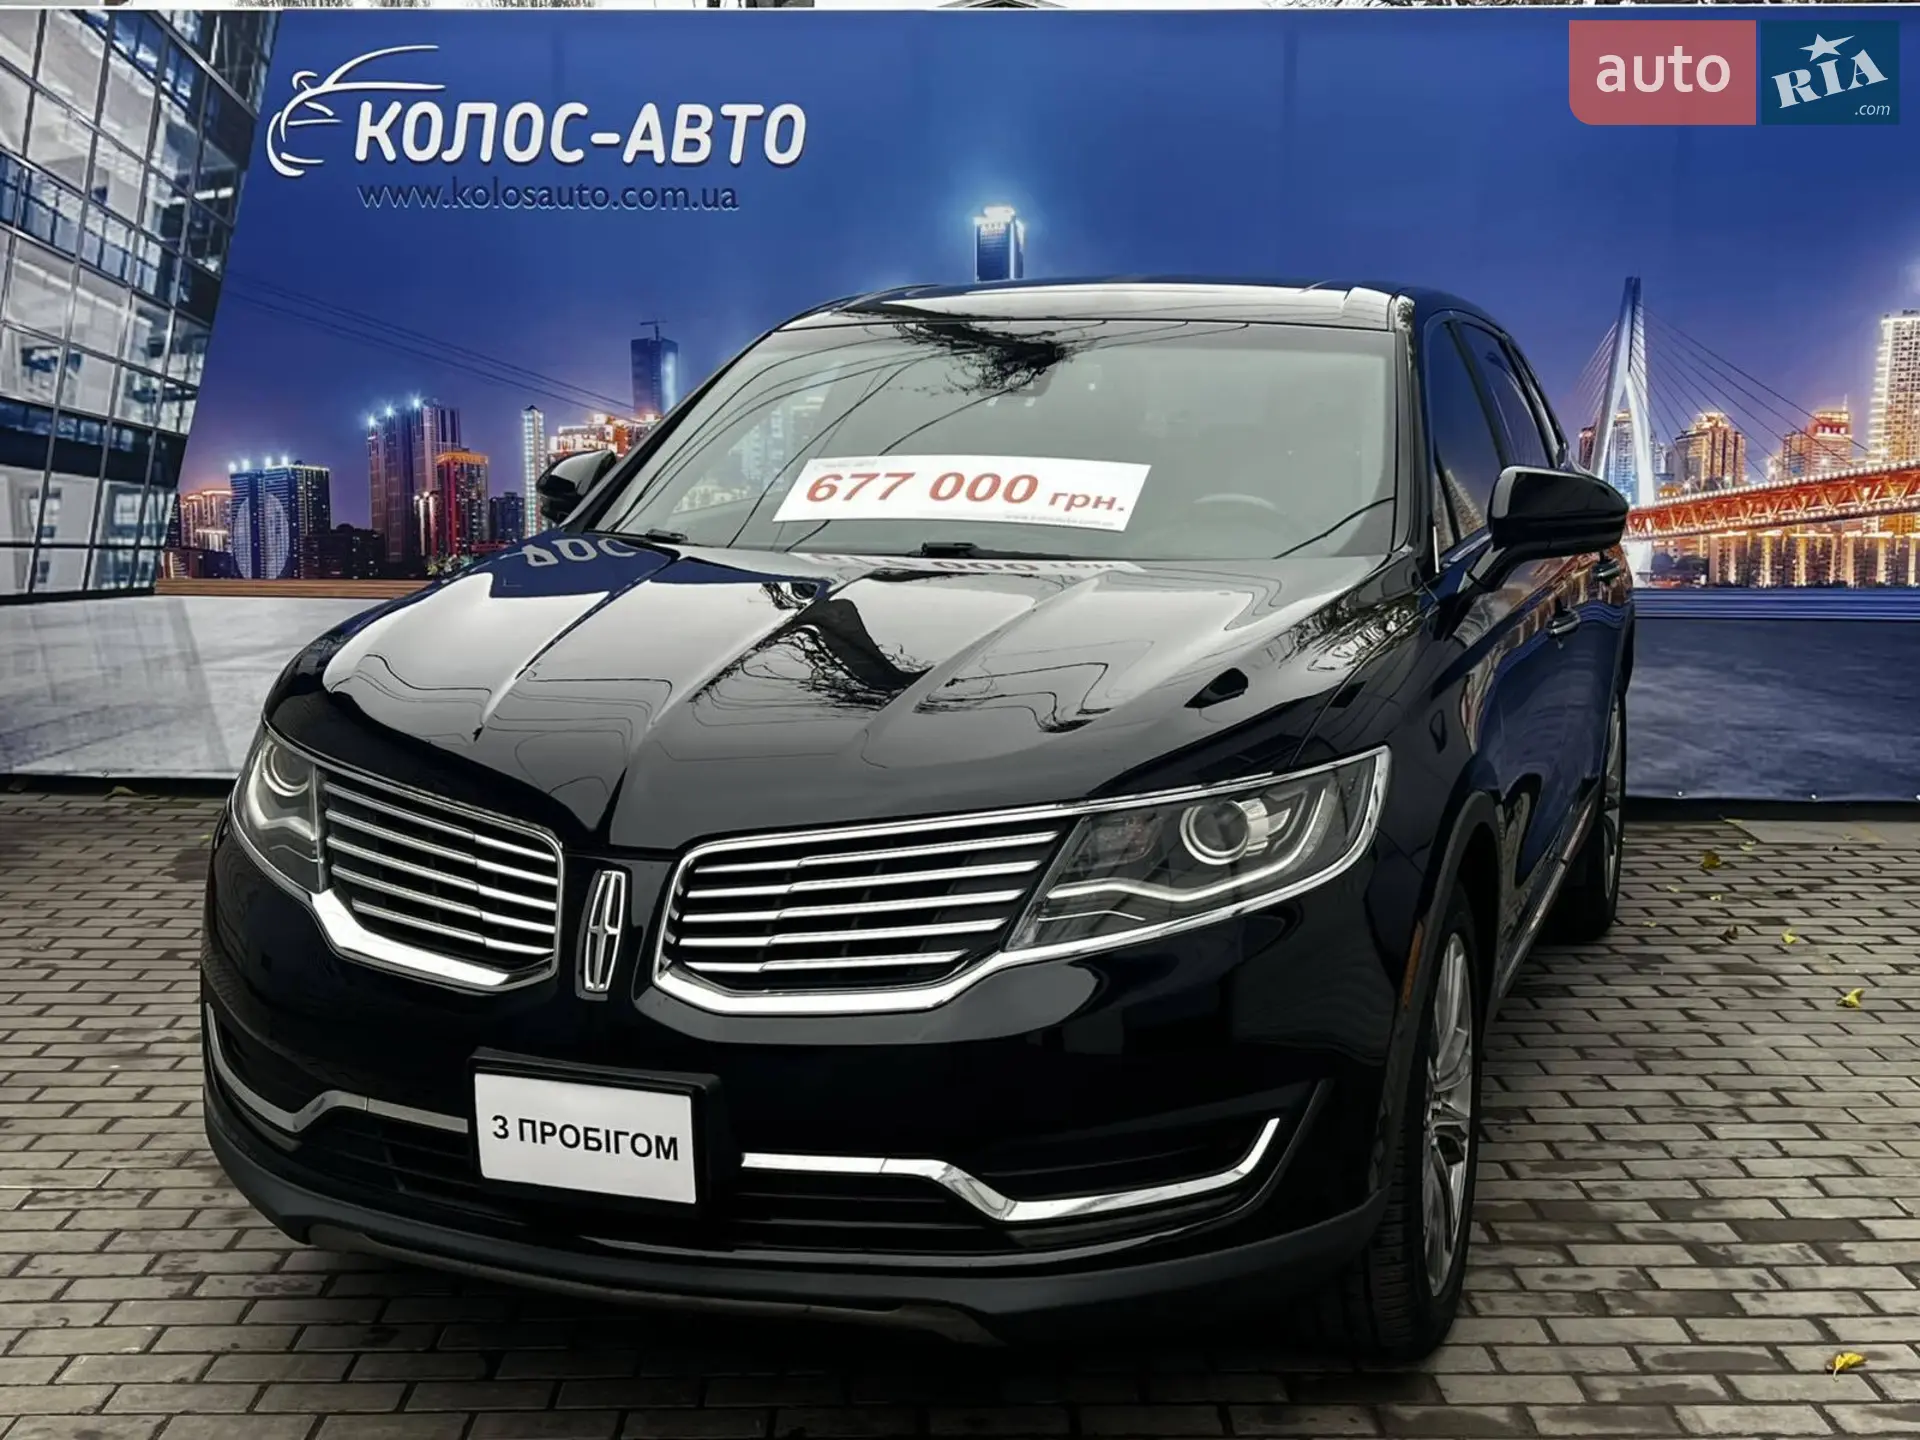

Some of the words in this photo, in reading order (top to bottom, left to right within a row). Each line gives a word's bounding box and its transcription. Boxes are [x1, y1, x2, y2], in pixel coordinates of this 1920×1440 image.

[354, 100, 807, 166] КОЛОС-АВТО
[356, 177, 740, 212] www.kolosauto.com.ua
[806, 472, 915, 503] 677
[928, 472, 1040, 503] 000
[1048, 492, 1125, 512] грн.
[518, 1118, 679, 1161] ПРОБІГОМ
